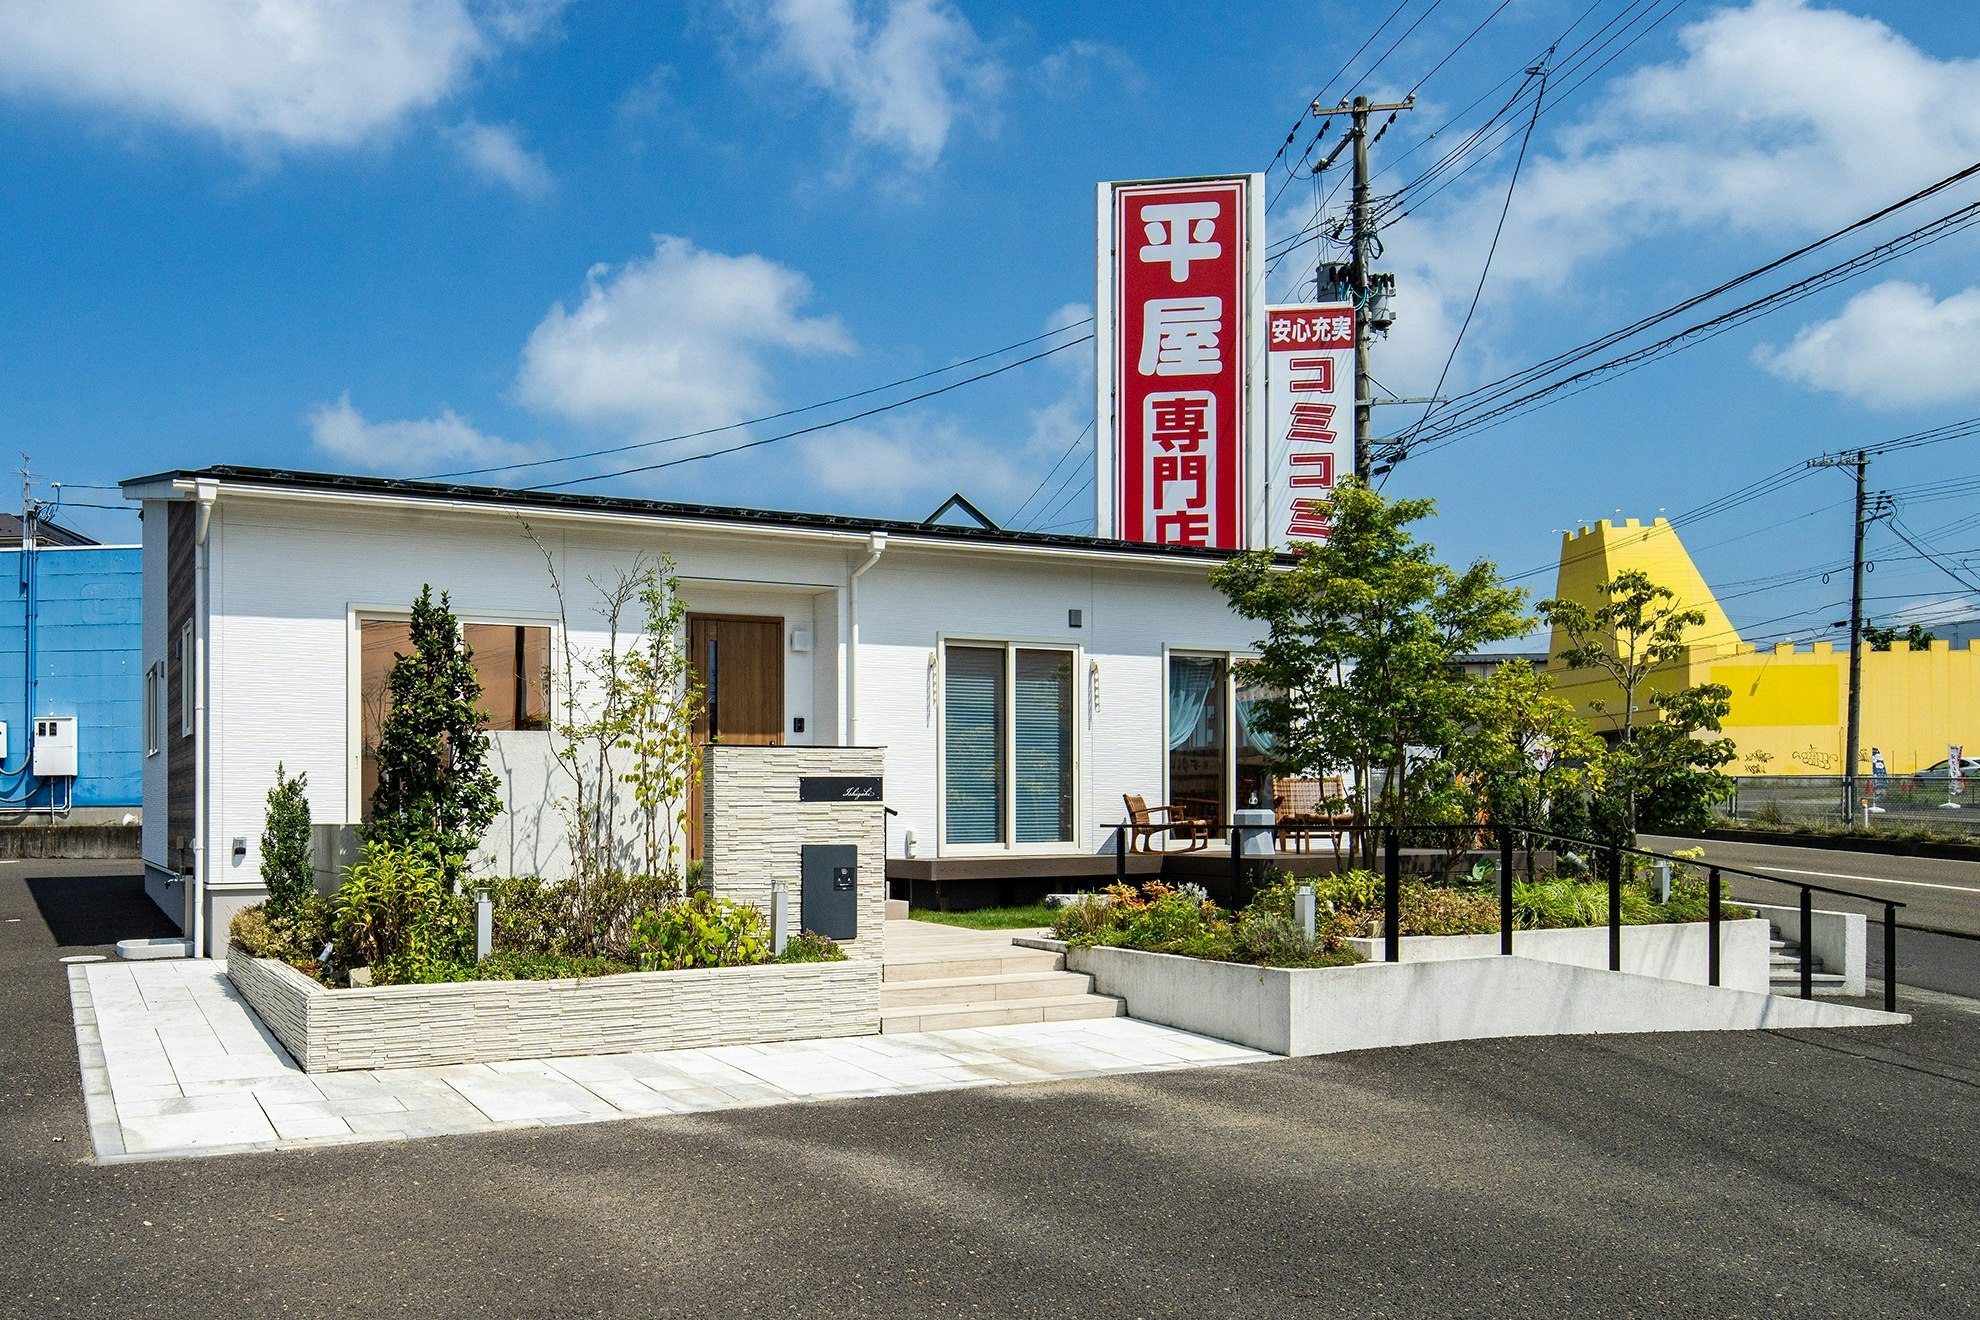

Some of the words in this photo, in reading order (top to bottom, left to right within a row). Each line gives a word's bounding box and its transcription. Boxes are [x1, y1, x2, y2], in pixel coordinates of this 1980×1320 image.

[1271, 315, 1352, 343] 安心充実
[1285, 356, 1338, 556] コミコミ
